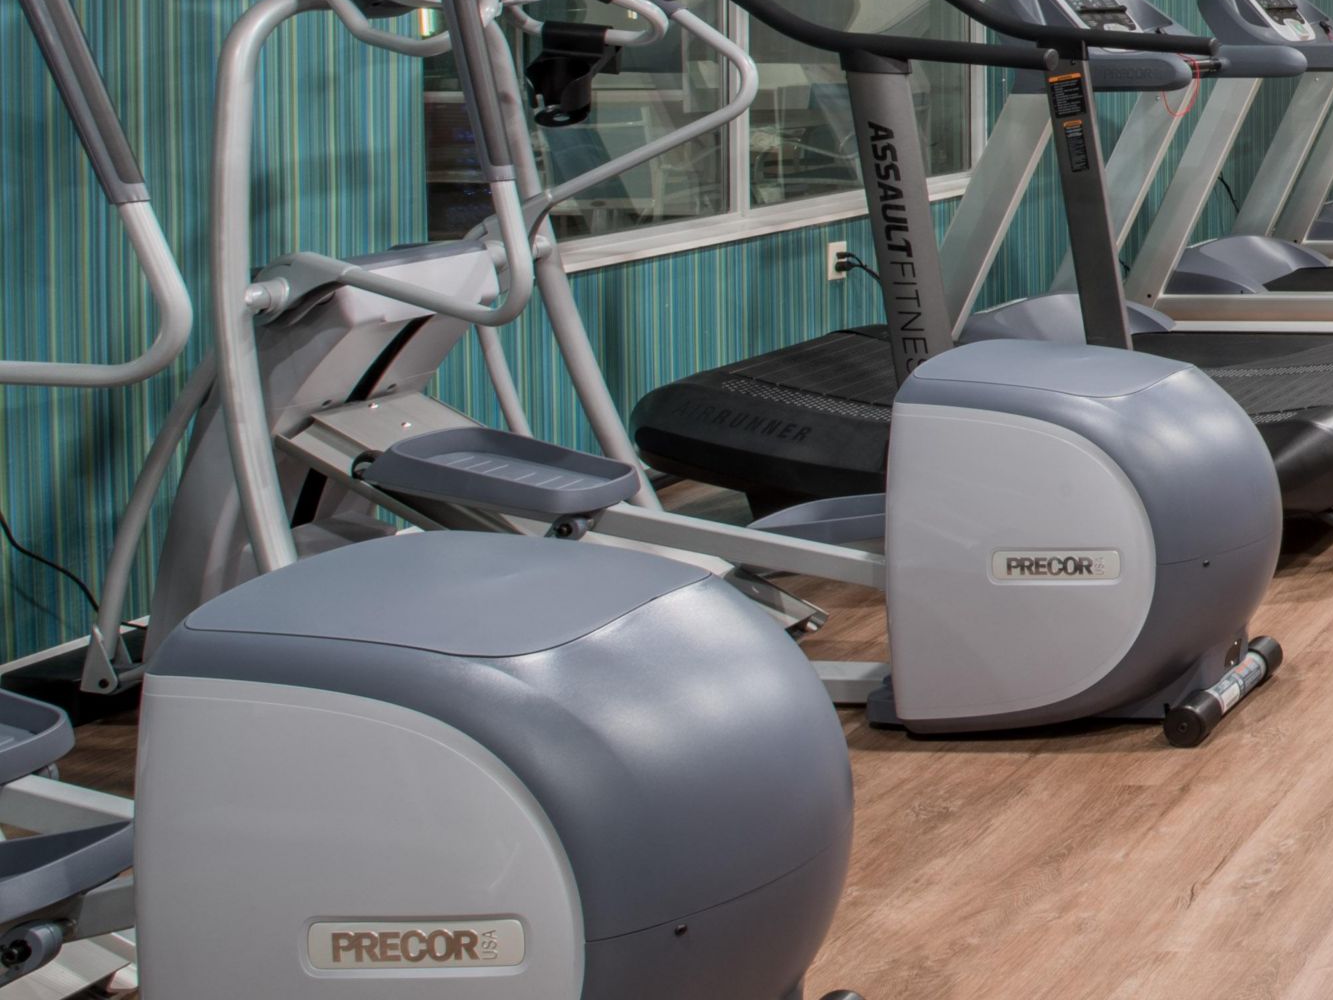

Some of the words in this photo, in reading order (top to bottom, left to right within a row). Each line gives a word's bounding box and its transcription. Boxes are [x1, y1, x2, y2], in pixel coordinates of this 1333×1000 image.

[868, 120, 929, 375] ASSAULTFITNES
[672, 400, 813, 442] AIRRUNNER
[1006, 556, 1093, 576] PRECOR
[331, 928, 480, 963] PRECOR
[481, 929, 498, 961] USA
